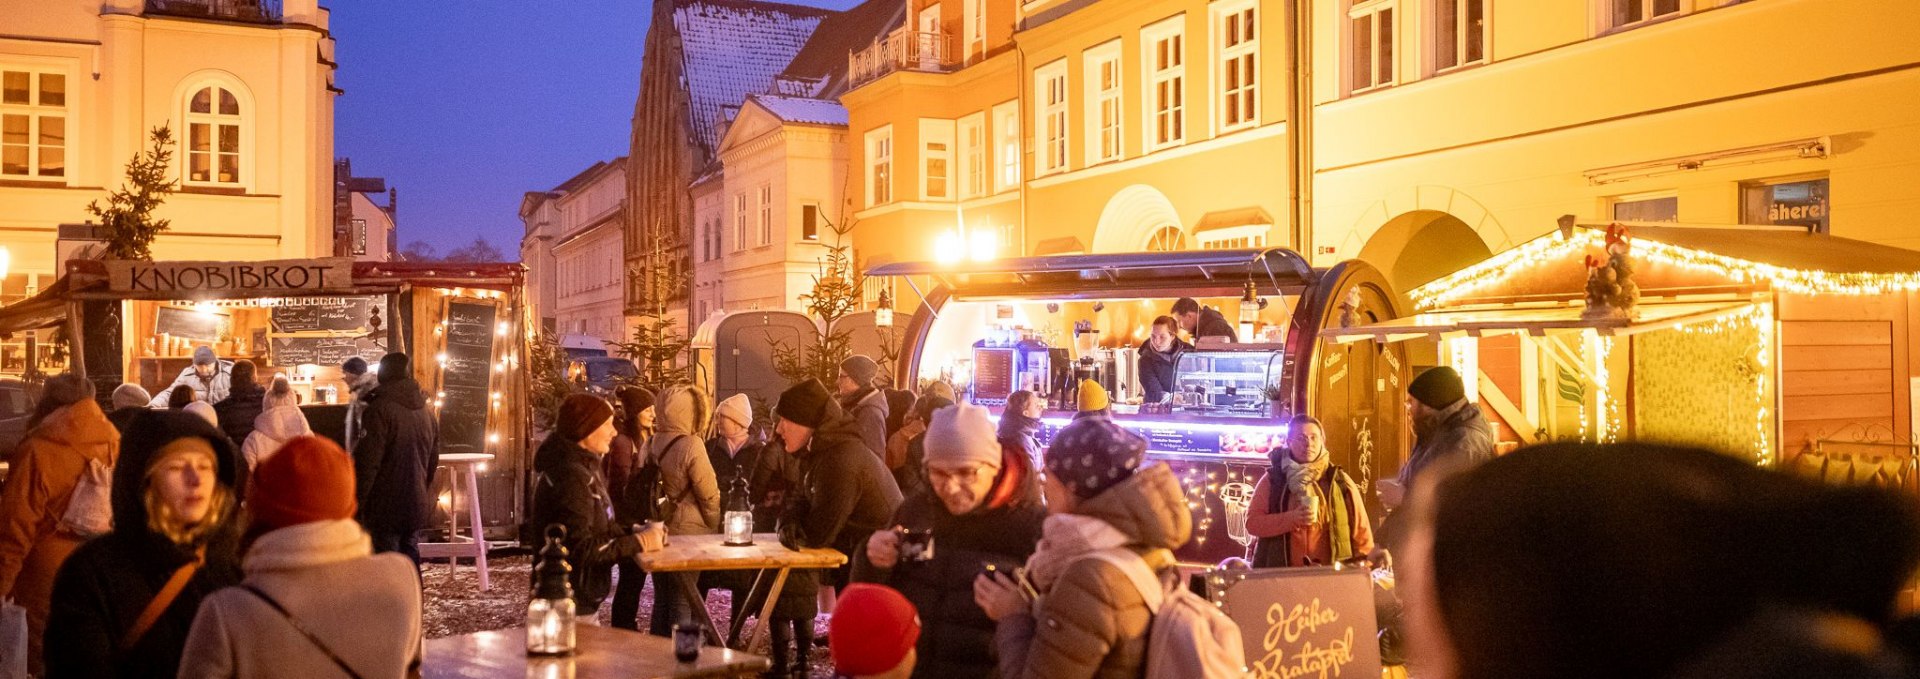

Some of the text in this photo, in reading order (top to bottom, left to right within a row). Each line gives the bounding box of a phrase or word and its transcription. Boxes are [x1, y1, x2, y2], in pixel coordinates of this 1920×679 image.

[131, 265, 333, 291] KNOBIBROT
[1383, 345, 1401, 372] FOLLOW
[1263, 597, 1340, 651] Heißer
[1252, 626, 1354, 679] Bratapfel
